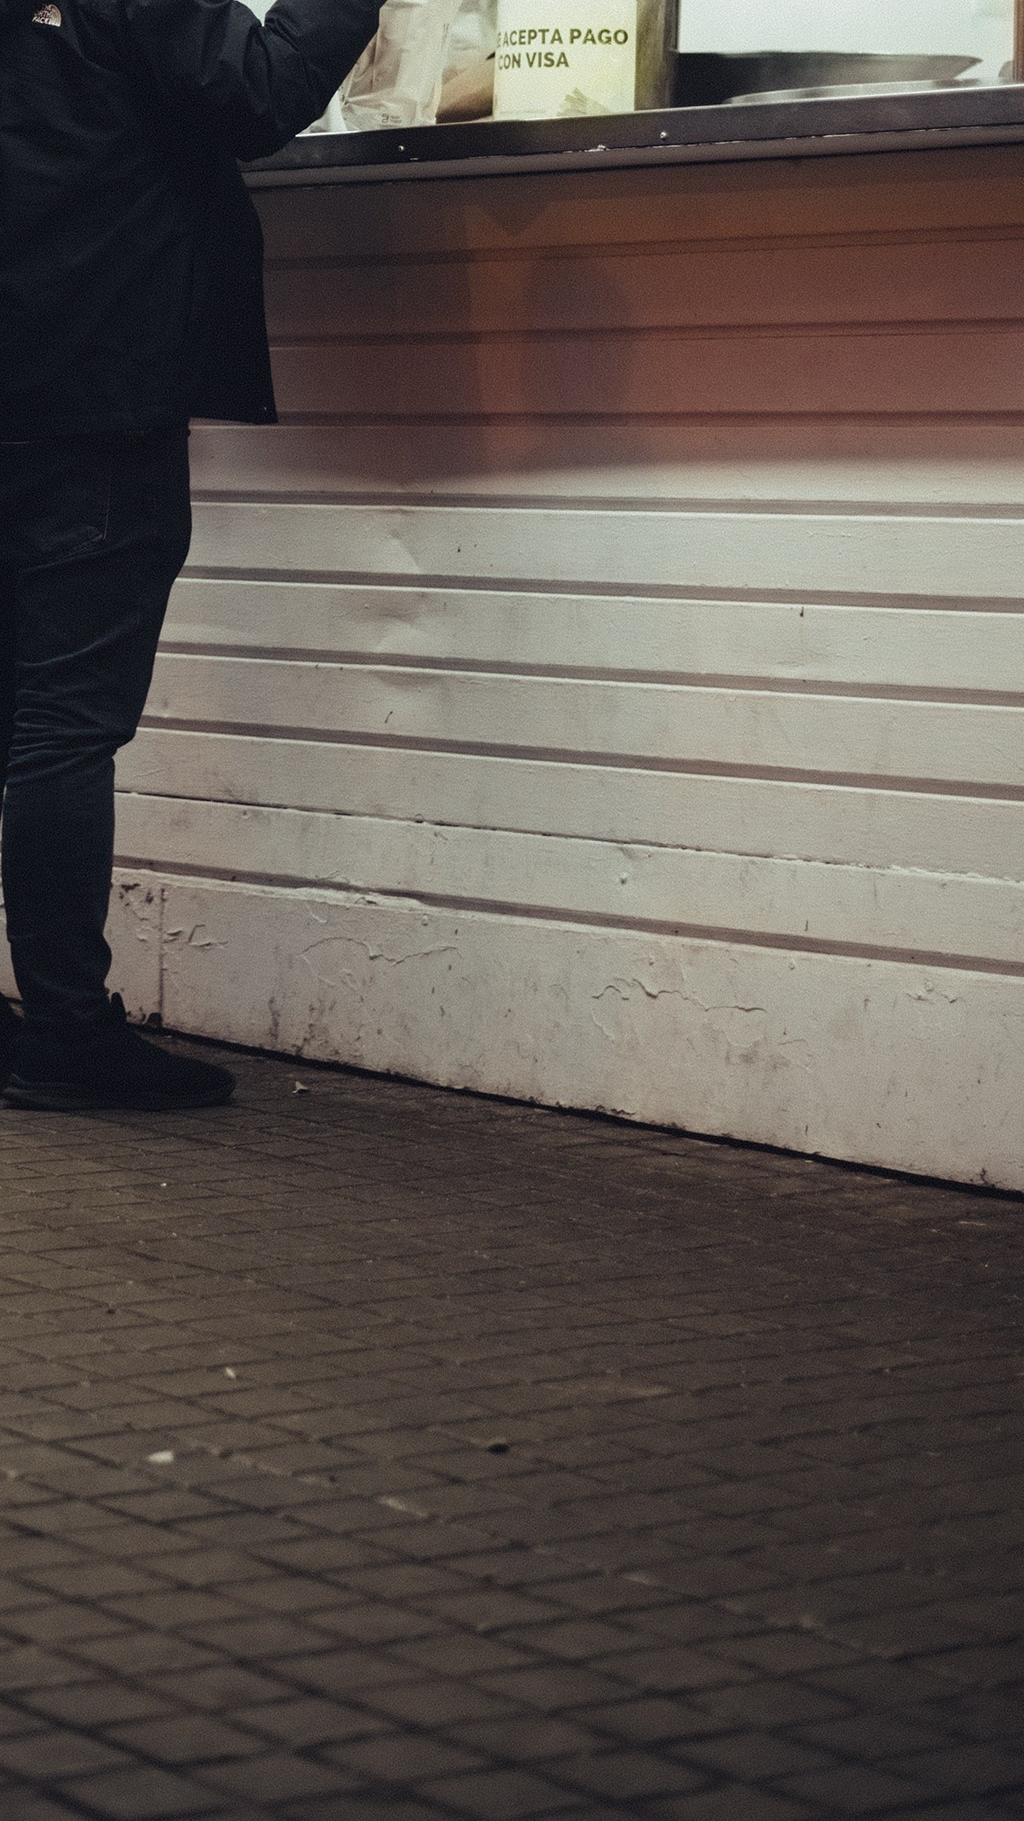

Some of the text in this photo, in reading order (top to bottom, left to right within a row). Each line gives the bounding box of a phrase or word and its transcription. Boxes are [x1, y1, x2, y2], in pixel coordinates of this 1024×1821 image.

[502, 28, 564, 47] ACEPTA
[569, 28, 629, 46] PAGO
[525, 51, 570, 68] VISA
